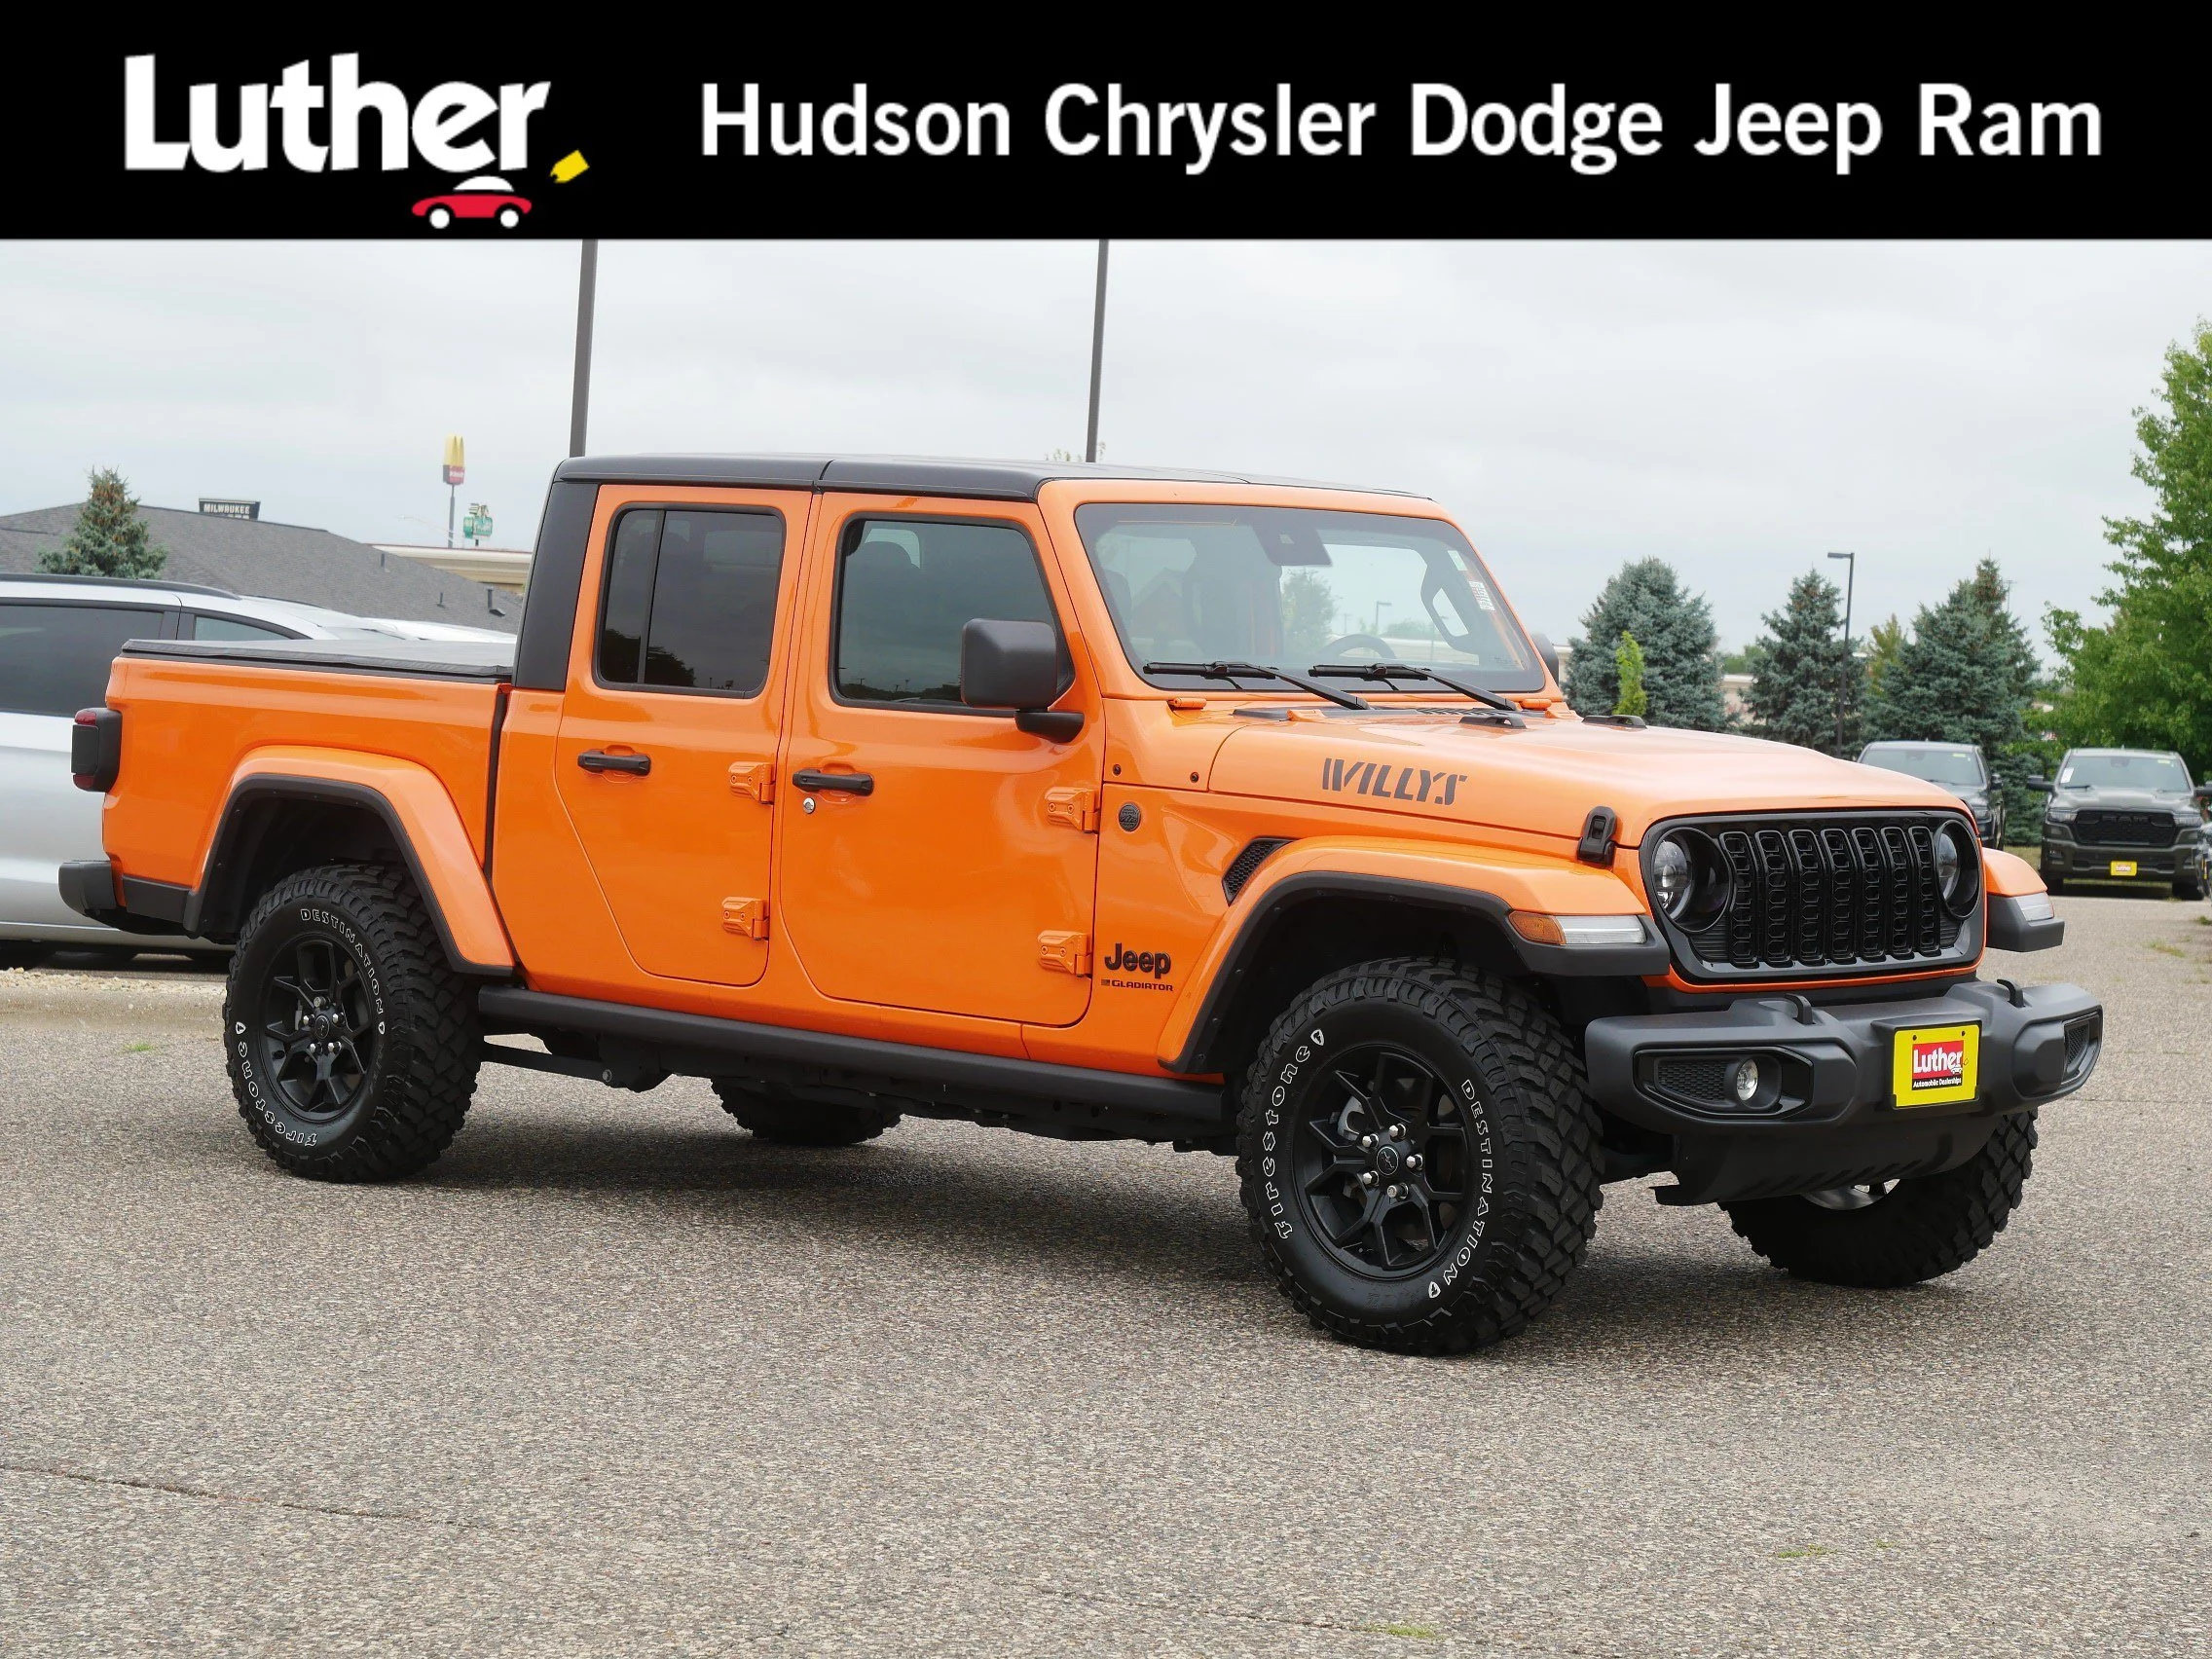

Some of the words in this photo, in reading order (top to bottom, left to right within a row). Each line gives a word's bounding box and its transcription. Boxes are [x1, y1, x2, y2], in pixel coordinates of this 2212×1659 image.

[203, 502, 250, 515] MILWAUKEE
[1322, 757, 1468, 806] WILLYS
[300, 907, 385, 1014] DESTINATION
[1104, 941, 1171, 979] Jeep
[1111, 979, 1174, 992] GLADIATOR
[1913, 1047, 1963, 1073] Luther
[1913, 1079, 1938, 1088] Automobile
[1939, 1077, 1961, 1086] Dealerships
[1443, 1079, 1493, 1287] DESTINATION
